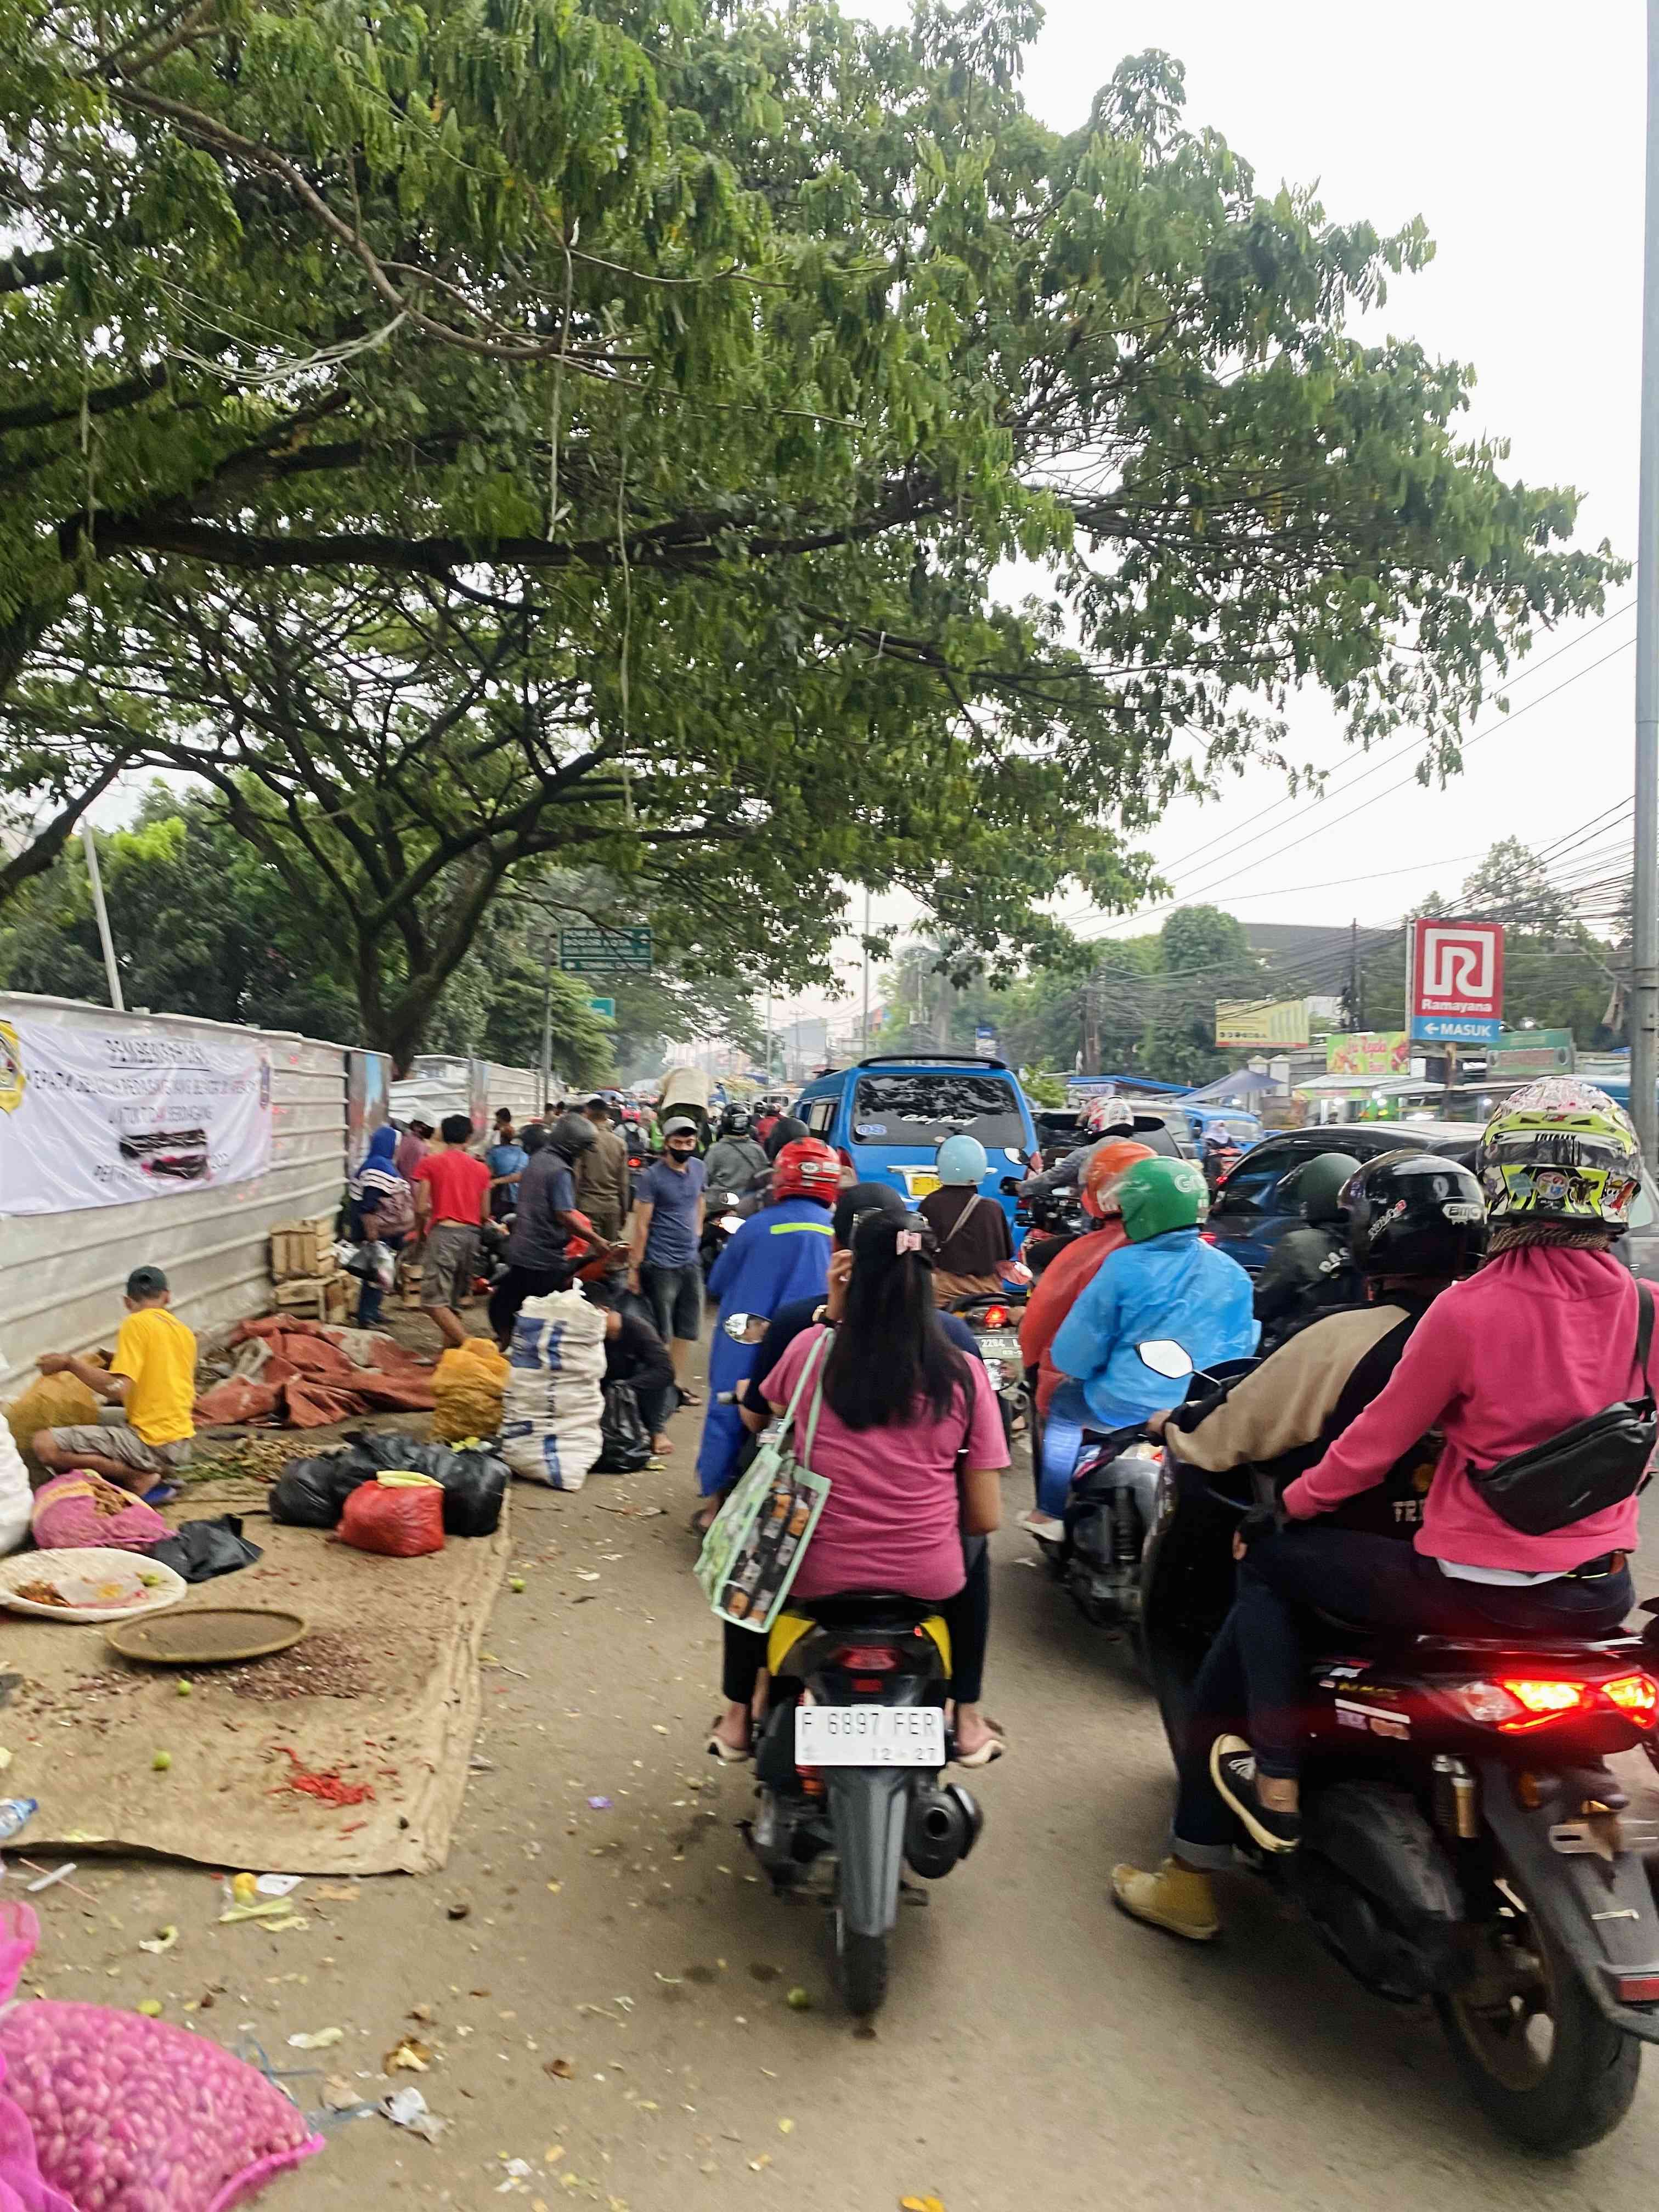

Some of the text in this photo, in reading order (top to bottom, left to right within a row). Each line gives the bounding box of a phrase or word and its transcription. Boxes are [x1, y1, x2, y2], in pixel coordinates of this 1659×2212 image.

[1421, 998, 1493, 1013] Ramayana
[1440, 1023, 1492, 1037] MASUK
[802, 1712, 936, 1736] F 6897 FER
